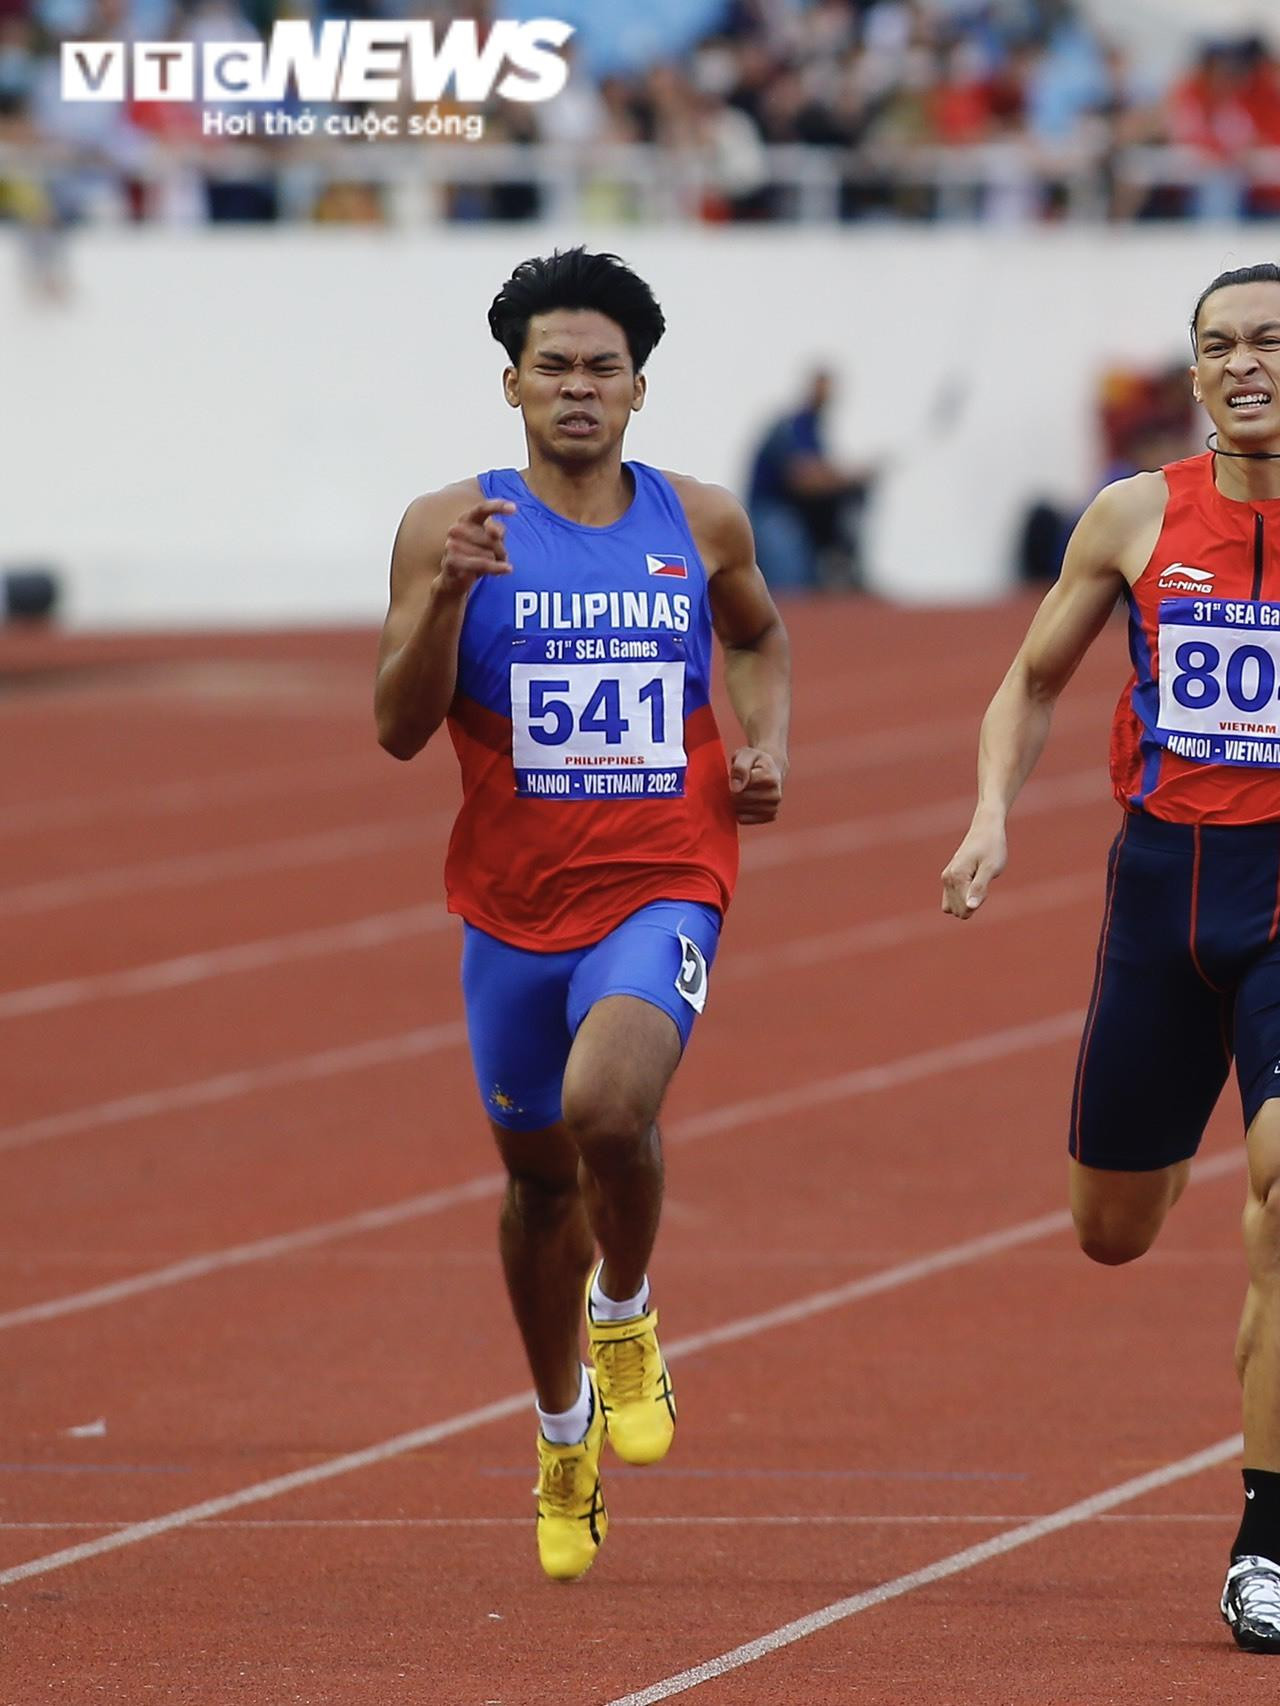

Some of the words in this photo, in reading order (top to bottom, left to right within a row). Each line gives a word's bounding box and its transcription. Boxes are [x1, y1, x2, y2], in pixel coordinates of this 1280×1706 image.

[1158, 579, 1213, 594] LI-NING
[514, 590, 691, 633] PILIPINAS
[1225, 604, 1256, 625] SEA
[576, 640, 606, 659] SEA
[610, 638, 658, 659] Games
[527, 678, 666, 746] 541
[1219, 721, 1277, 734] VIETNAM
[1167, 735, 1211, 758] HANOI
[565, 756, 645, 765] PHILIPPINES
[527, 774, 570, 794] HANOI
[584, 774, 643, 793] VIETNAM
[647, 772, 678, 793] 2022
